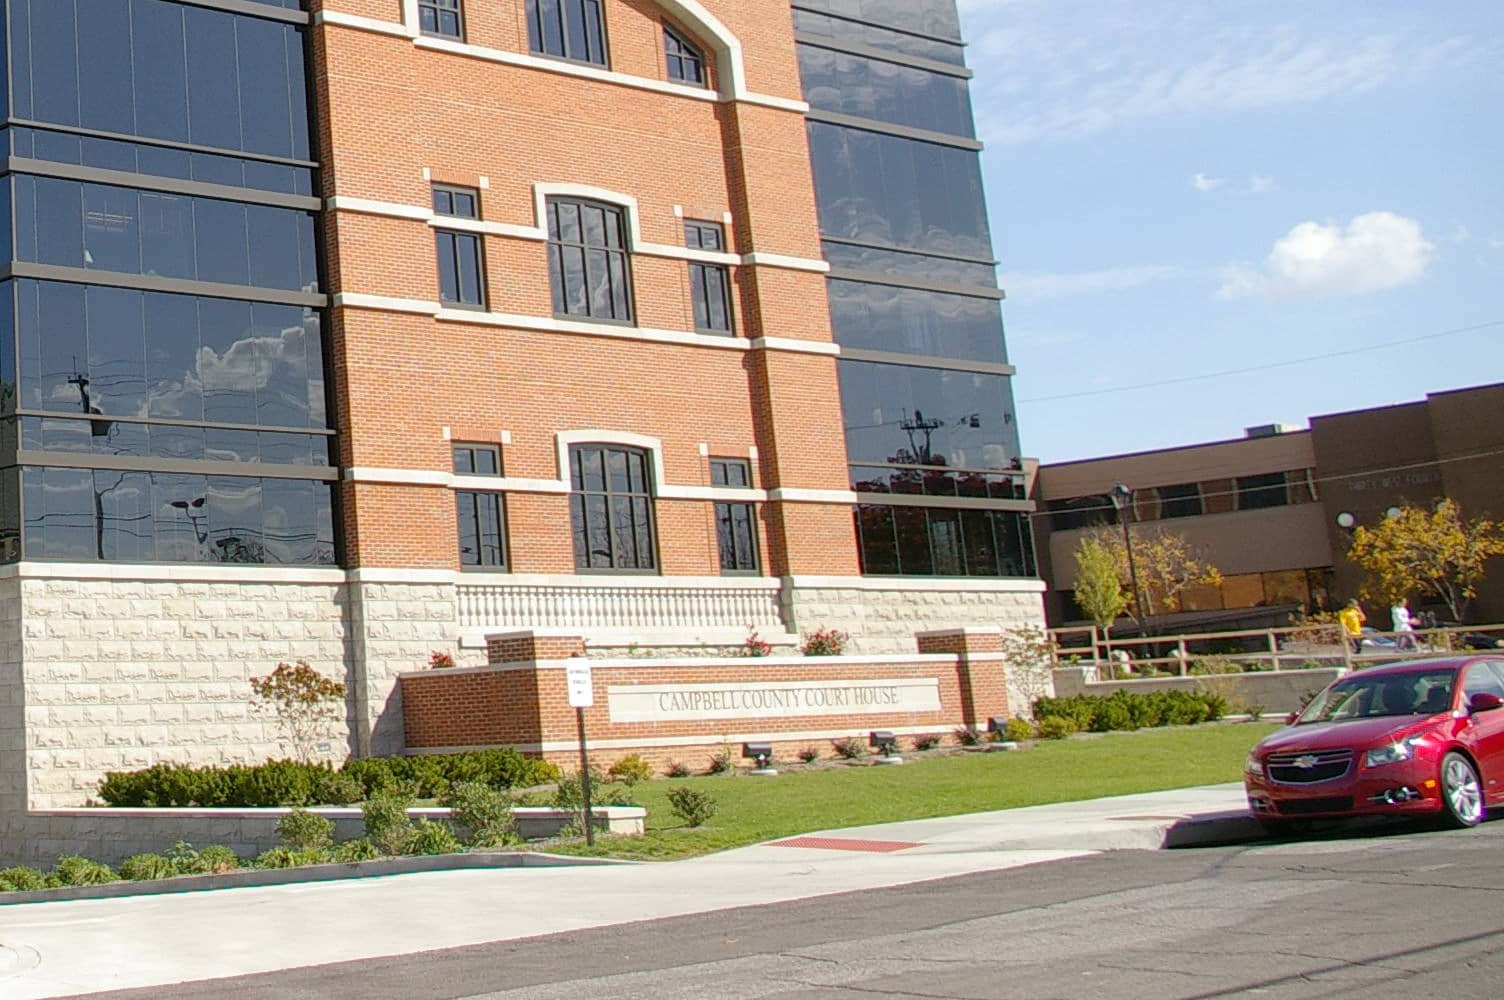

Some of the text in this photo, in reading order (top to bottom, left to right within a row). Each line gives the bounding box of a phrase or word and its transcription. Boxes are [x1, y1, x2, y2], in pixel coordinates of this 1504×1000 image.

[659, 687, 898, 711] CAMPBELL COUNTY COURT HOUSE
